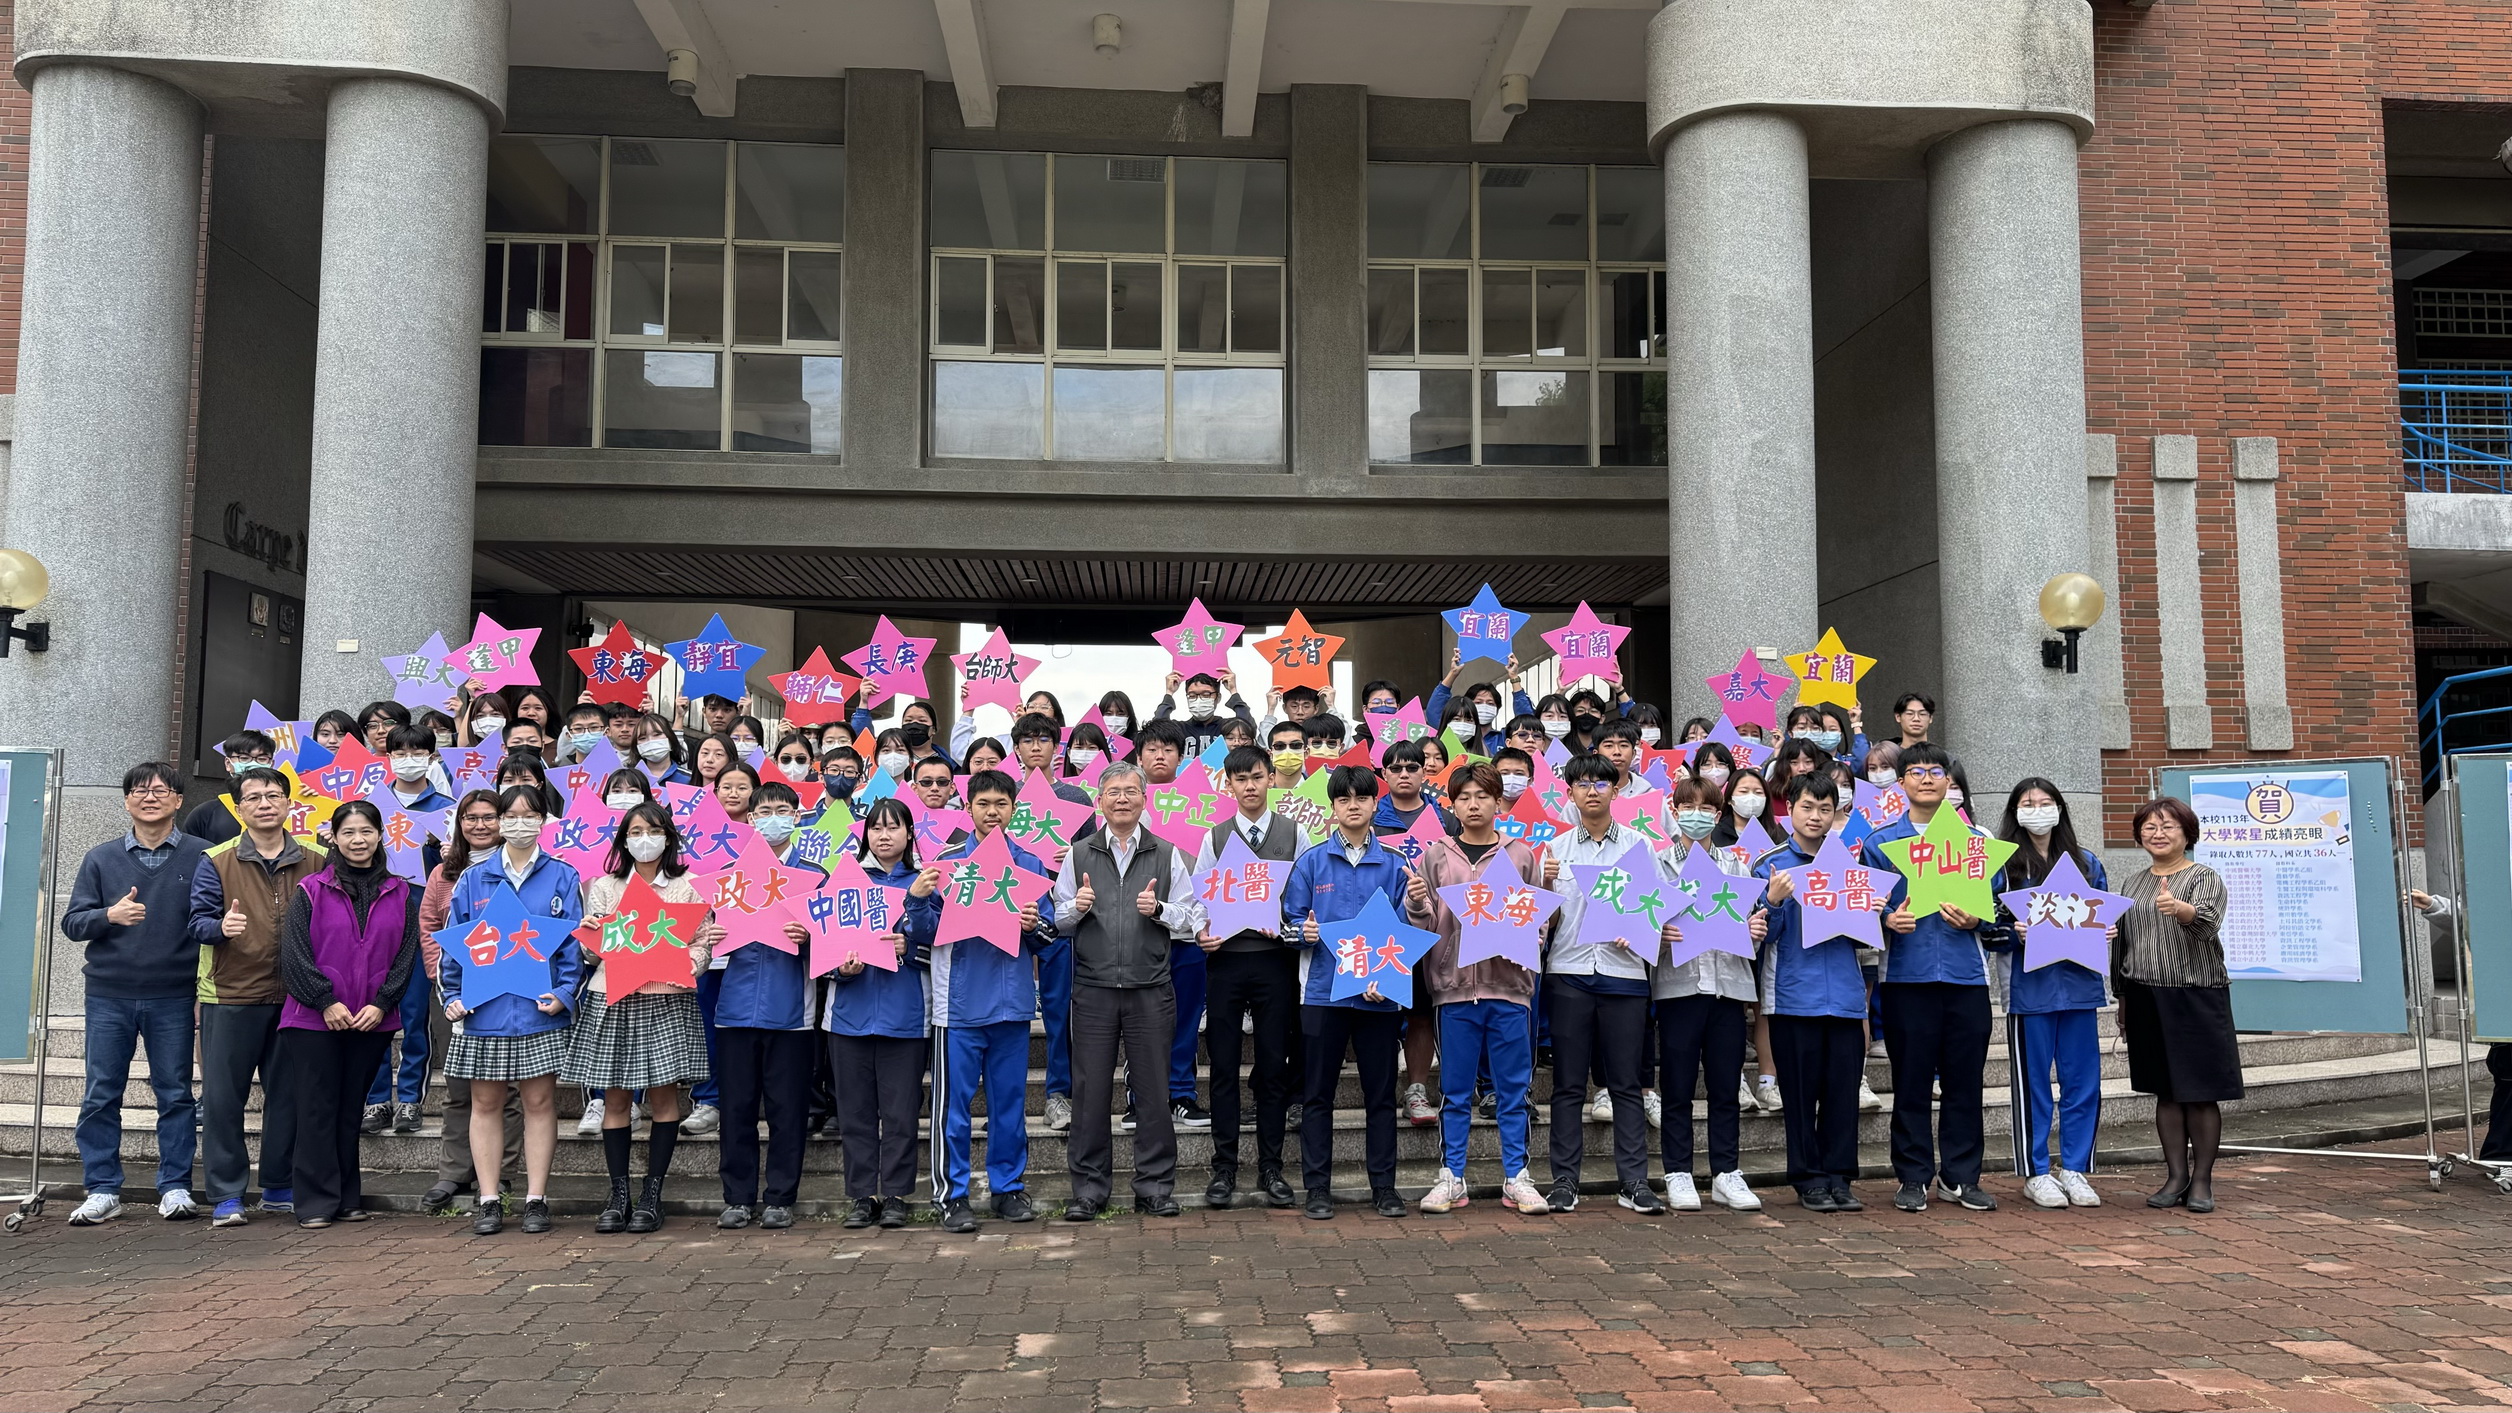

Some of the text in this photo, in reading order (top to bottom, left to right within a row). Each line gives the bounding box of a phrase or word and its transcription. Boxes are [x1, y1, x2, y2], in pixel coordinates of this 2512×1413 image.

[1174, 625, 1227, 658] 逢甲
[1458, 608, 1511, 643] 宜蘭
[466, 637, 523, 675] 逢甲
[682, 639, 743, 673] 靜宜
[861, 641, 919, 676] 長庚
[1271, 634, 1327, 668] 元智
[1560, 630, 1612, 661] 宜蘭
[396, 656, 457, 689] 興大
[588, 649, 653, 683] 東海
[965, 652, 1020, 684] 台師大
[1802, 652, 1855, 685] 宜蘭
[783, 672, 844, 704] 輔仁
[1723, 671, 1773, 702] 嘉大
[1184, 735, 1219, 760] GA
[321, 761, 388, 800] 中原
[1154, 787, 1219, 830] 中正
[2200, 814, 2250, 824] 本校113年
[2256, 788, 2282, 819] 賀
[1494, 815, 1557, 850] 中央
[2203, 828, 2324, 842] 大學繁星成績亮眼
[1908, 835, 1989, 881] 中山醫
[713, 867, 789, 914] 政大
[943, 861, 1021, 914] 清大
[1202, 862, 1274, 904] 北醫
[1589, 867, 1665, 933] 成大
[1803, 869, 1876, 913] 高醫
[807, 886, 889, 935] 中國醫
[1461, 882, 1540, 927] 東海
[2026, 891, 2107, 931] 淡江
[464, 919, 546, 967] 台大
[600, 908, 688, 954] 成大
[1337, 934, 1411, 979] 清大
